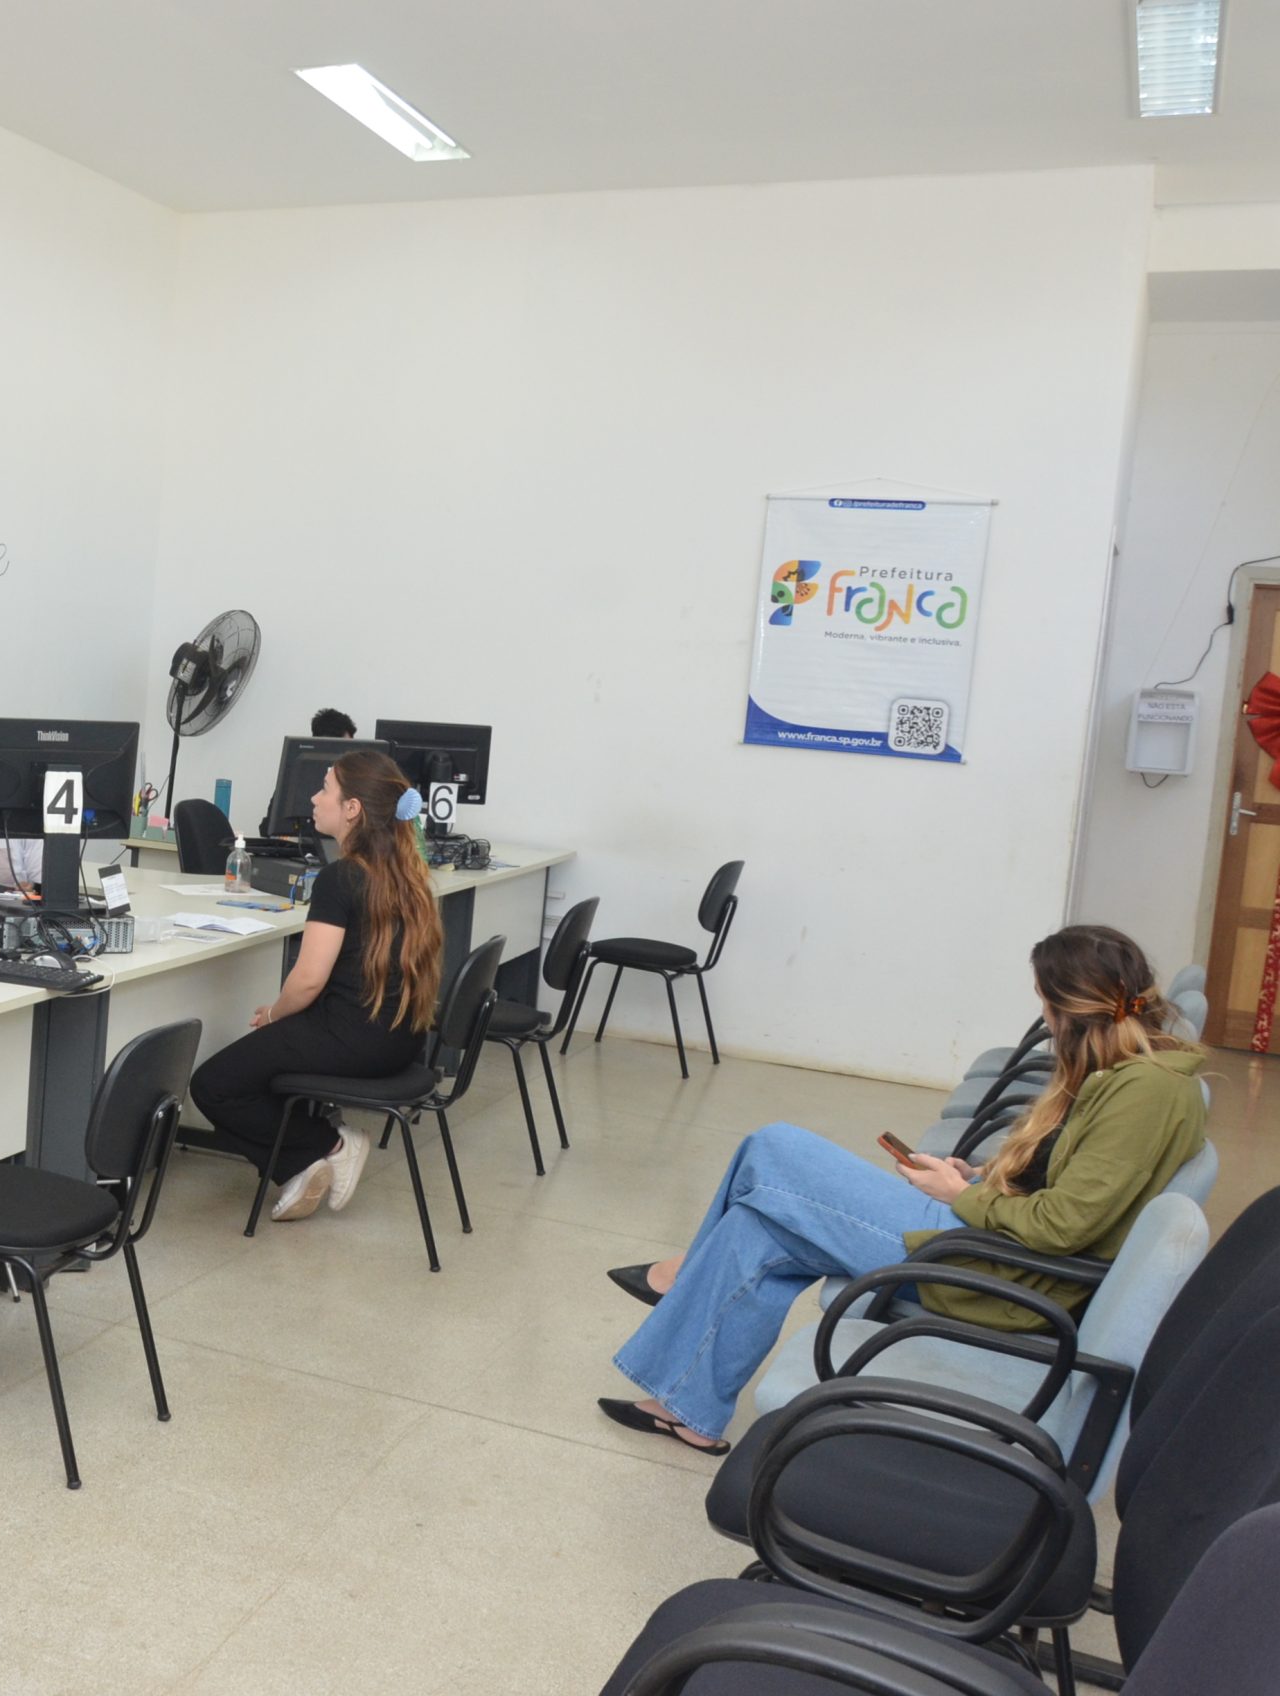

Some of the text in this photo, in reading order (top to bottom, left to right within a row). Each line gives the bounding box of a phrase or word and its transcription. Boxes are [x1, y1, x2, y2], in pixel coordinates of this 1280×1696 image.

[859, 566, 954, 581] Prefeitura
[824, 631, 865, 641] Moderna,
[870, 634, 908, 643] vibrante
[918, 637, 962, 647] inclusiva.
[778, 731, 883, 747] www.franca.sp.gov.br
[47, 779, 78, 824] 4
[431, 785, 453, 820] 6
